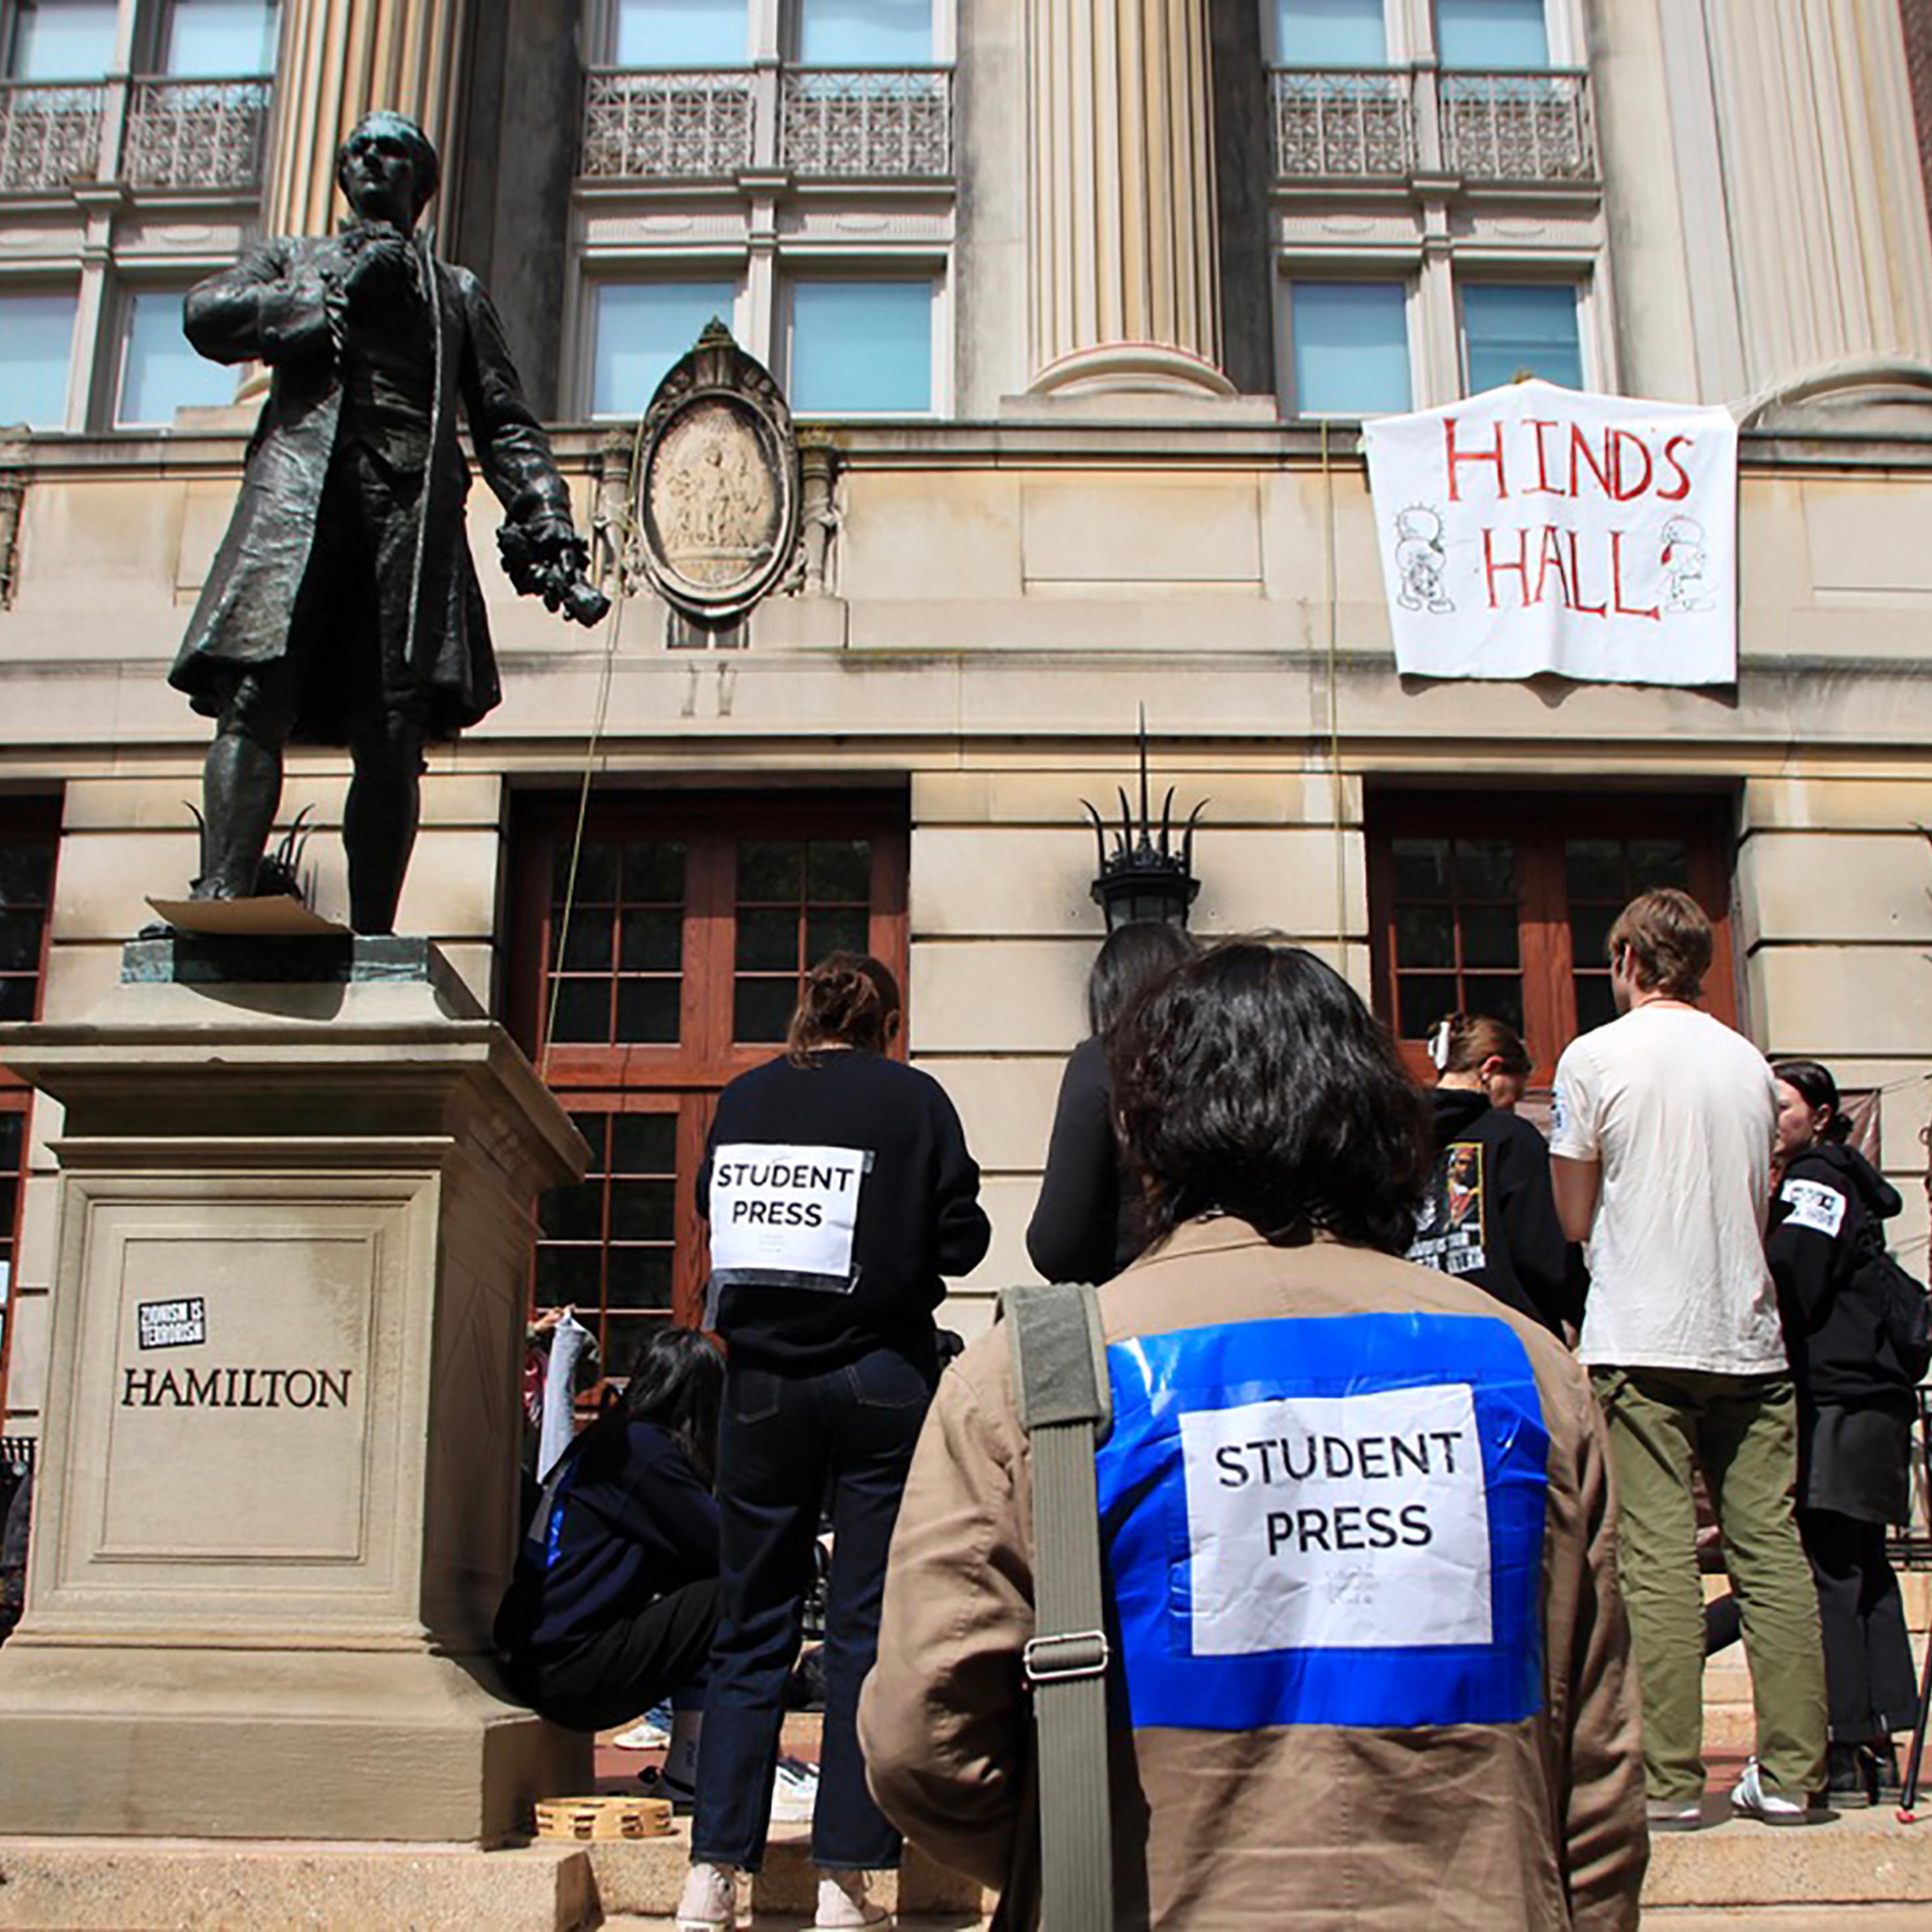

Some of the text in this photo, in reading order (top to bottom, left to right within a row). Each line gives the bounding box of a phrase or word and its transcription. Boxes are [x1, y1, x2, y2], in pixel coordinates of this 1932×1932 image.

[1481, 524, 1660, 620] HALL
[717, 1163, 854, 1192] STUDENT
[732, 1200, 823, 1228] PRESS
[121, 1367, 353, 1408] HAMILTON
[1216, 1431, 1463, 1487] STUDENT
[1266, 1504, 1432, 1557] PRESS
